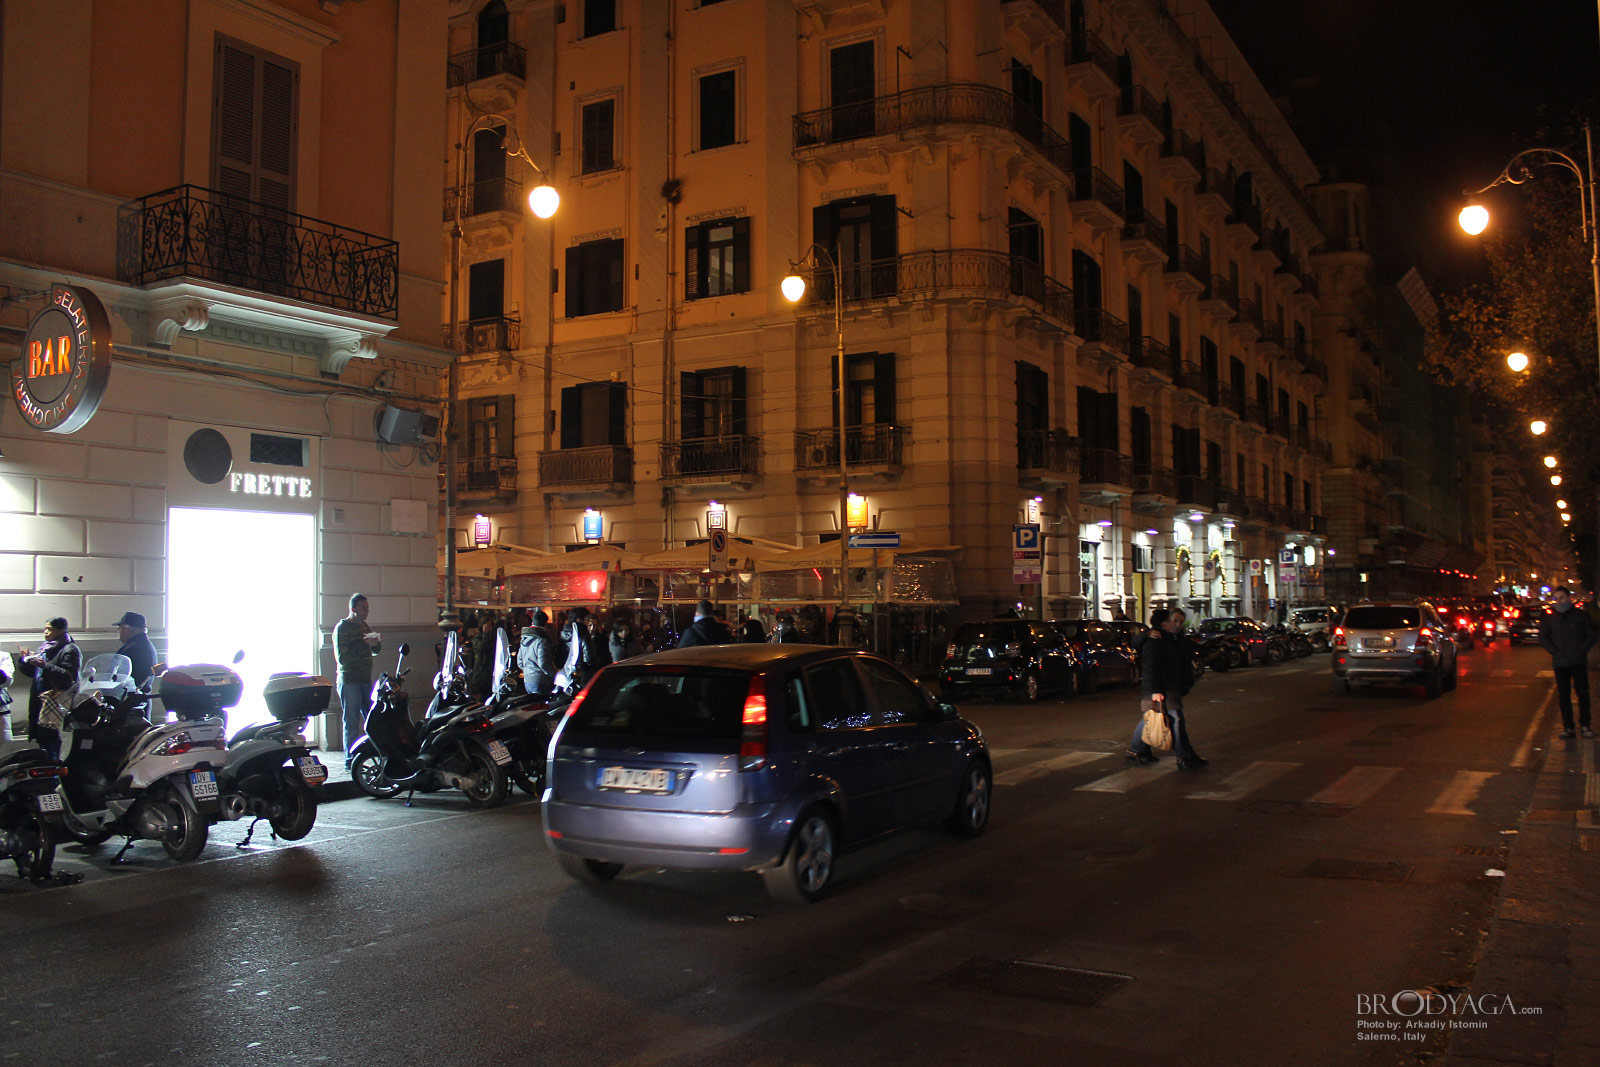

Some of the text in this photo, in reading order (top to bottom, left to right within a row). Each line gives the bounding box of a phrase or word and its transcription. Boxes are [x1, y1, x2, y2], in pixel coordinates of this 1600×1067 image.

[28, 336, 72, 378] BAR
[230, 472, 312, 498] FRETTE
[1020, 529, 1034, 546] P
